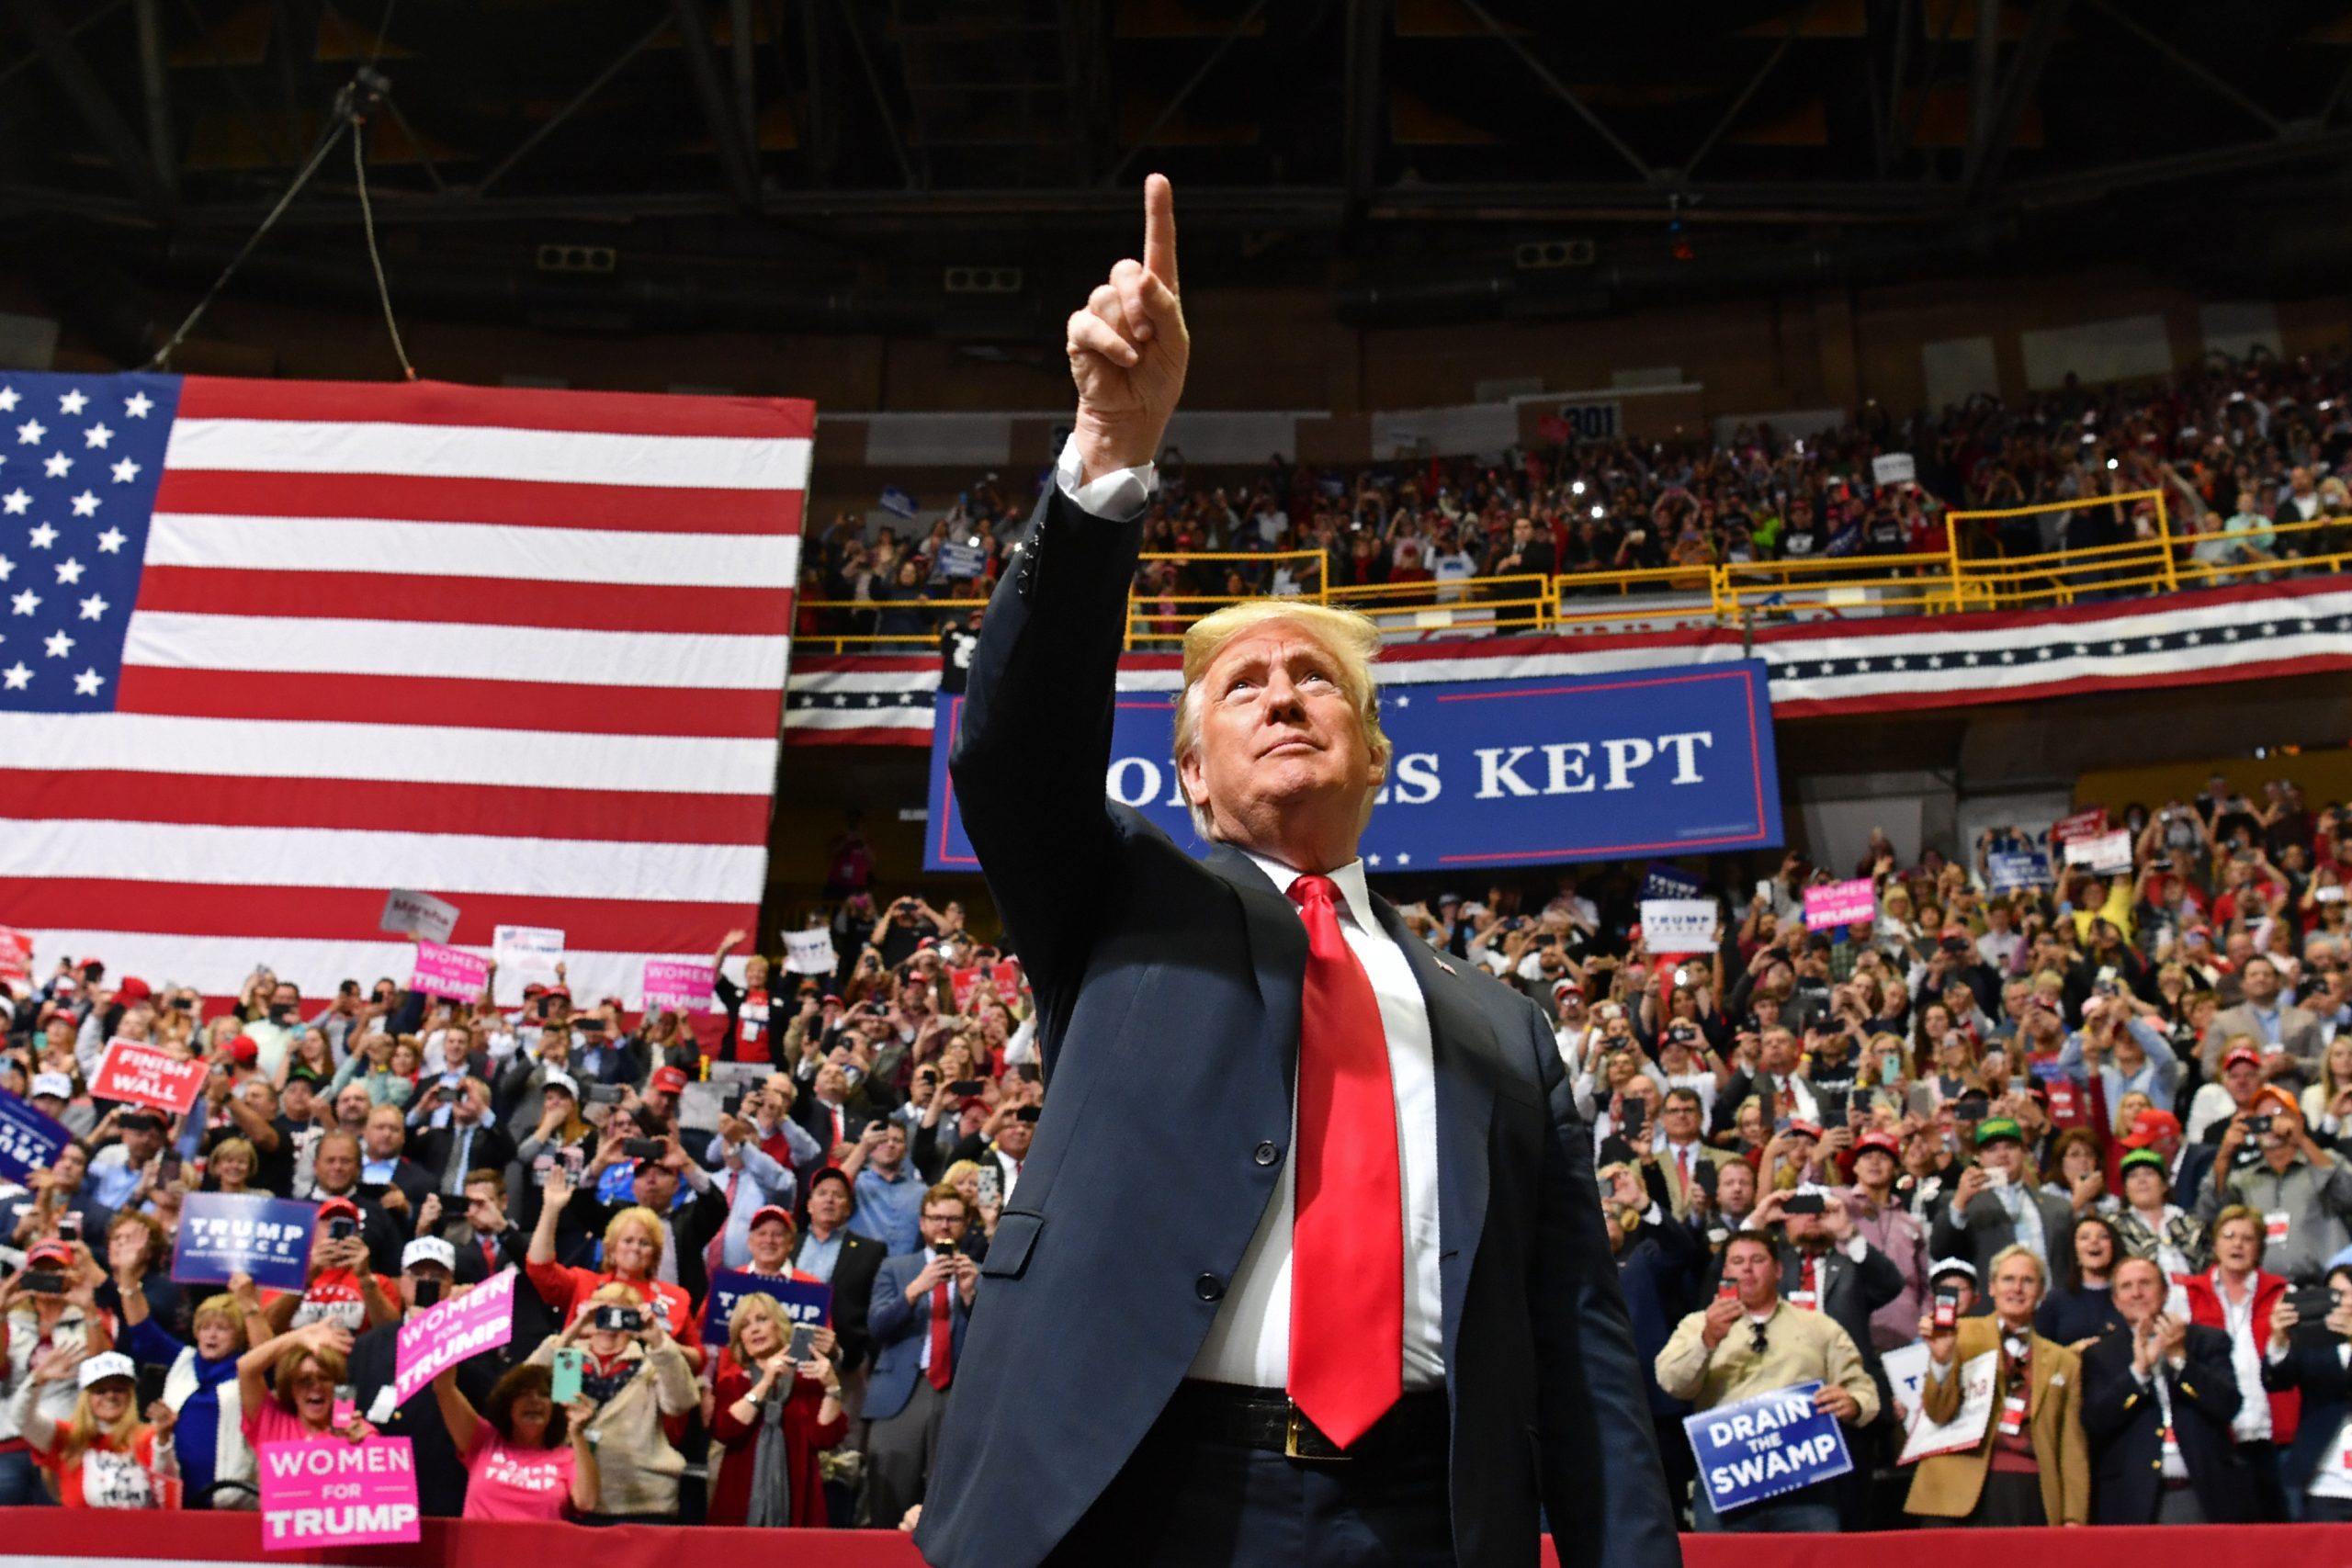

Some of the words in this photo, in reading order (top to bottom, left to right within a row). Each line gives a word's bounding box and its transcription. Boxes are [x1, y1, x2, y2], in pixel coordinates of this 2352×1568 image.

[1563, 407, 1614, 439] 301
[1473, 731, 1713, 799] KEPT
[1807, 882, 1872, 903] WOMEN
[1649, 915, 1710, 925] TRUMP
[1807, 904, 1874, 927] TRUMP
[423, 947, 487, 974] WOMEN
[415, 973, 483, 998] TRUMP
[646, 966, 714, 984] WOMEN
[118, 1049, 193, 1079] FINISH
[112, 1072, 177, 1102] WALL
[189, 1218, 304, 1242] TRUMP
[196, 1236, 290, 1256] PENCE
[402, 1274, 512, 1348] WOMEN
[718, 1291, 820, 1321] TMP
[433, 1319, 464, 1344] FOR
[397, 1315, 512, 1394] TRUMP
[1708, 1393, 1812, 1449] DRAIN
[1746, 1431, 1783, 1454] THE
[267, 1446, 411, 1478] WOMEN
[1711, 1433, 1837, 1495] SWAMP
[322, 1483, 361, 1500] FOR
[264, 1503, 418, 1540] TRUMP
